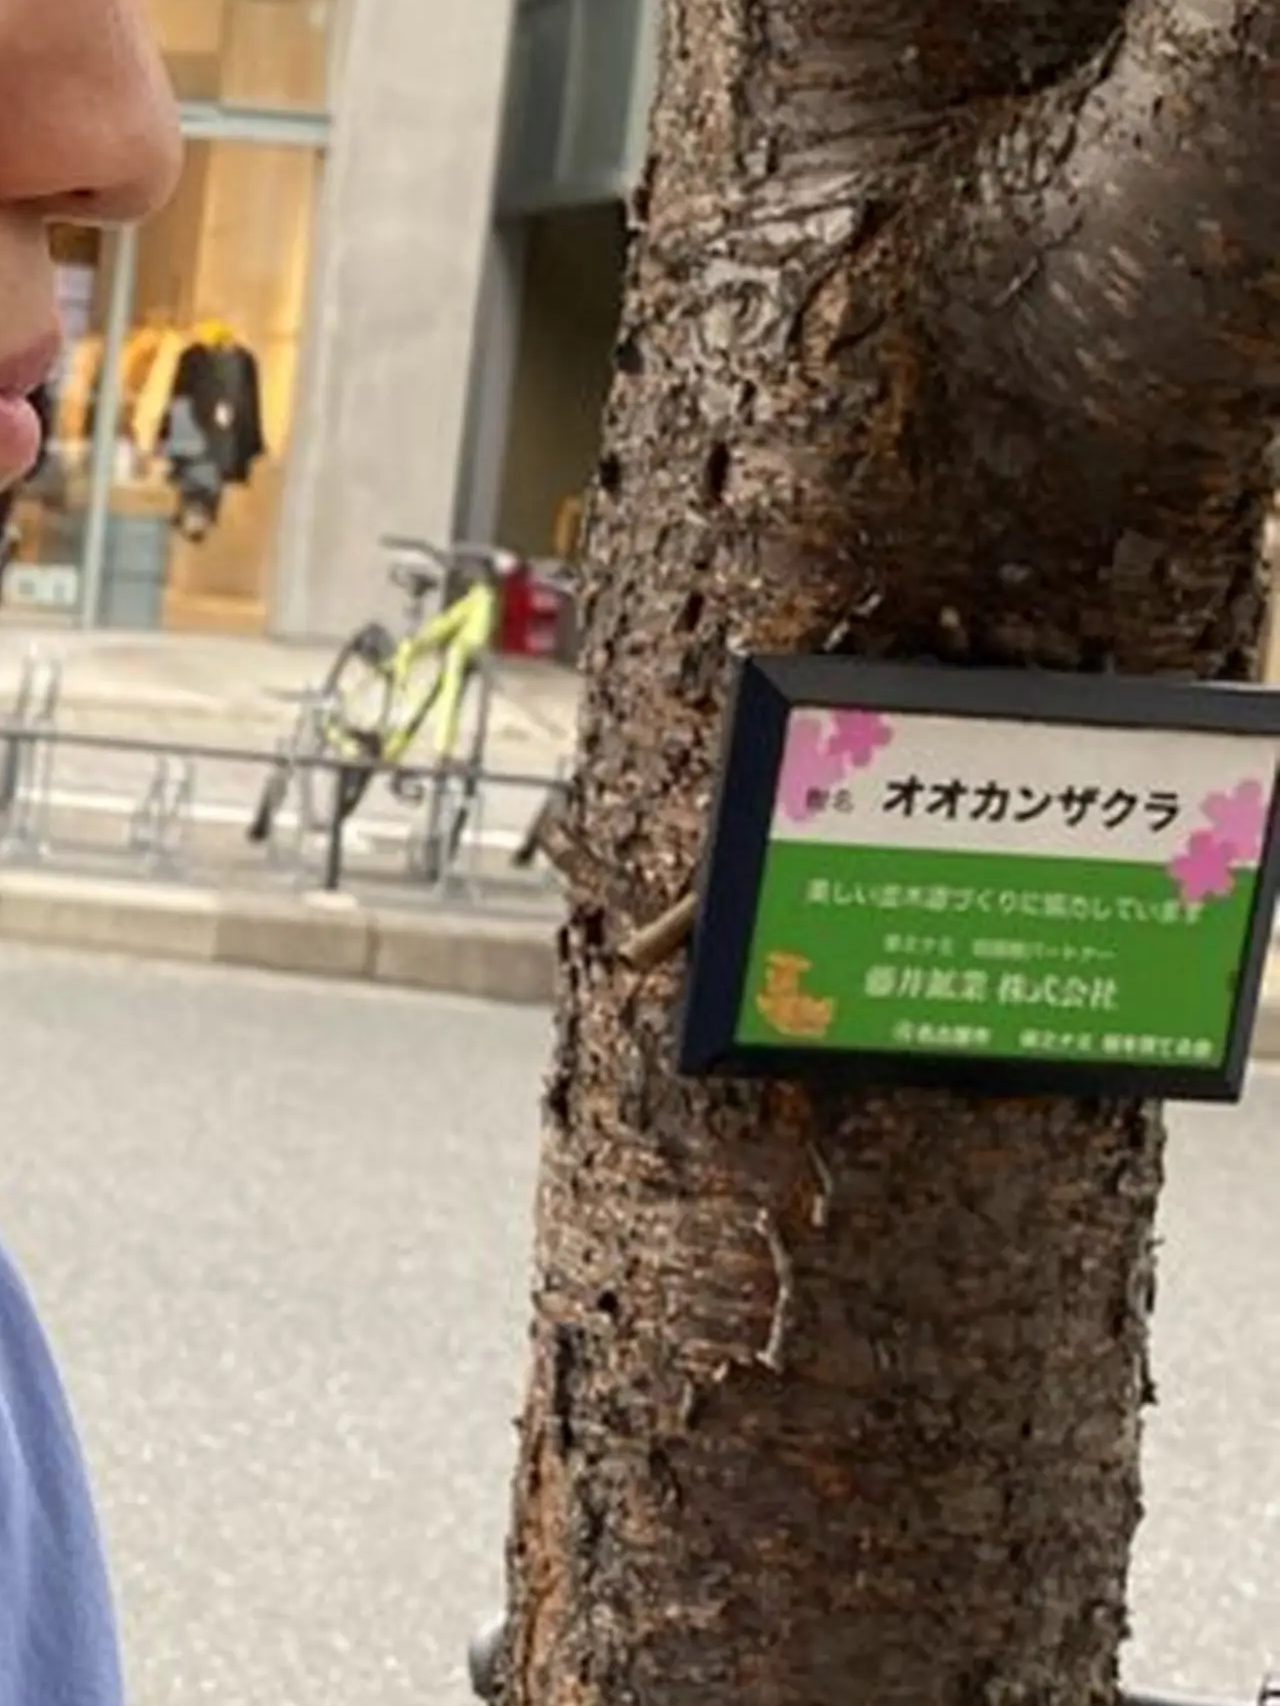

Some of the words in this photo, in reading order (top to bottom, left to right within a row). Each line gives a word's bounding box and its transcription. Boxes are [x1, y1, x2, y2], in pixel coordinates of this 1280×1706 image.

[883, 775, 1180, 831] オオカンザクラ
[997, 971, 1118, 1011] 株式会社
